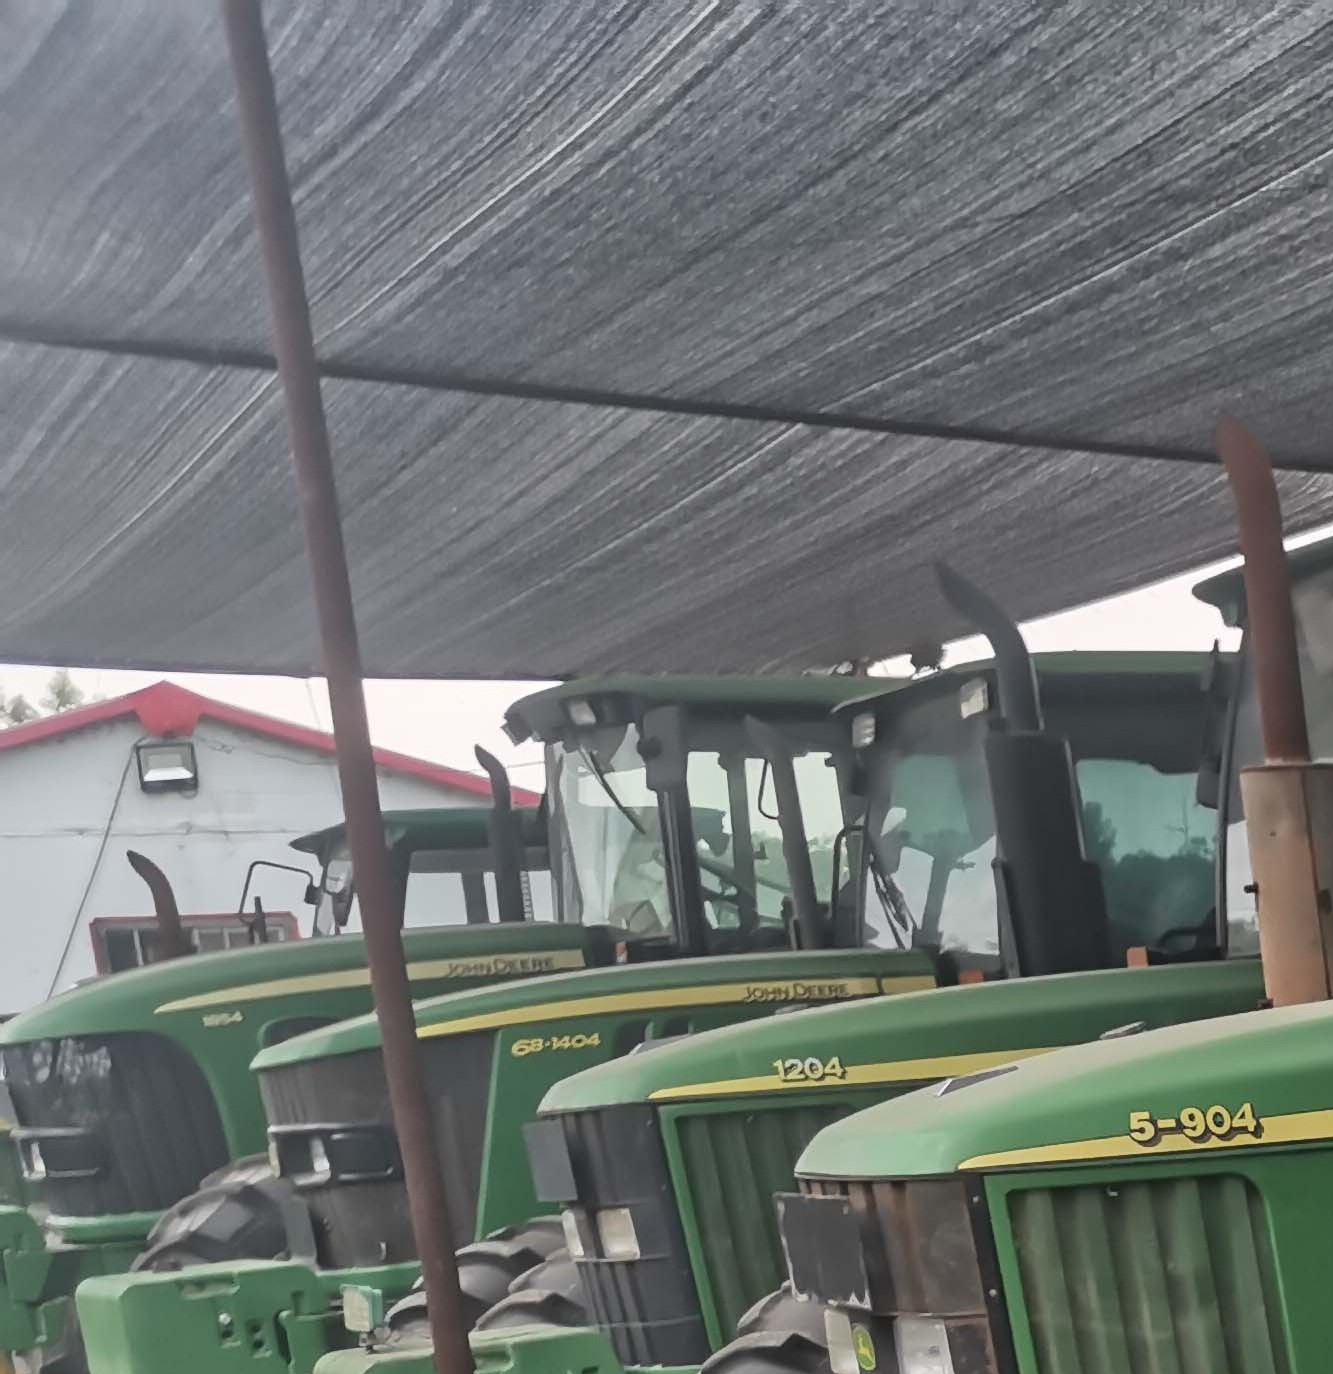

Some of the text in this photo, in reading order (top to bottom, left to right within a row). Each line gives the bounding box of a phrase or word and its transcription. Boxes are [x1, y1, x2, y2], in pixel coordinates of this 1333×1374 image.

[744, 982, 849, 1003] JOHN DEERE
[773, 1056, 847, 1082] 1204
[1129, 1102, 1262, 1146] 5-904
